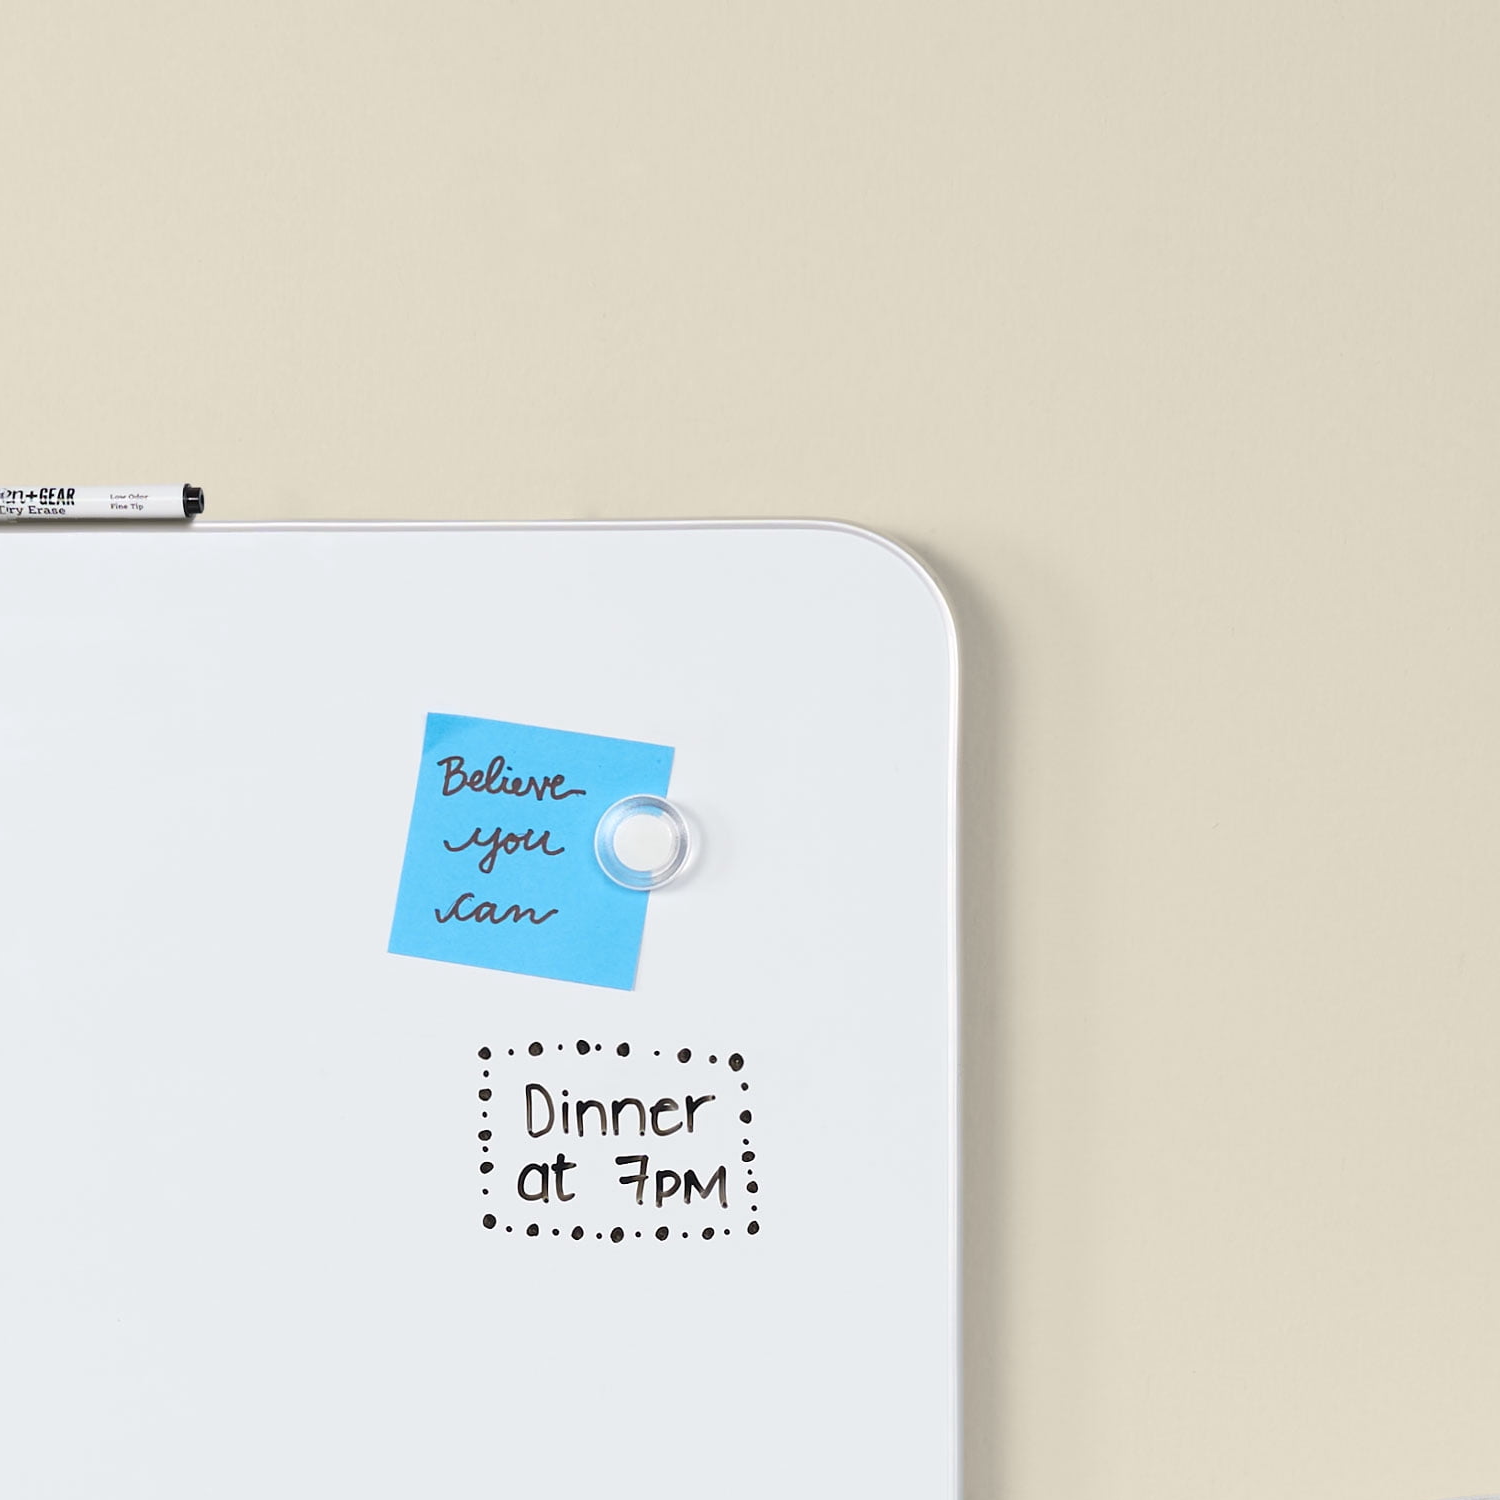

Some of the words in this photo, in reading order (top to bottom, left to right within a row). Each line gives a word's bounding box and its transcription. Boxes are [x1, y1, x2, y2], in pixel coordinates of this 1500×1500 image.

[28, 505, 66, 515] Erase
[110, 502, 128, 510] Fine
[129, 502, 144, 511] Tip
[437, 756, 586, 801] Believe
[444, 827, 565, 873] you
[435, 893, 558, 924] can
[526, 1084, 715, 1138] Dinner
[518, 1153, 576, 1203] at
[615, 1155, 727, 1208] 7PM
